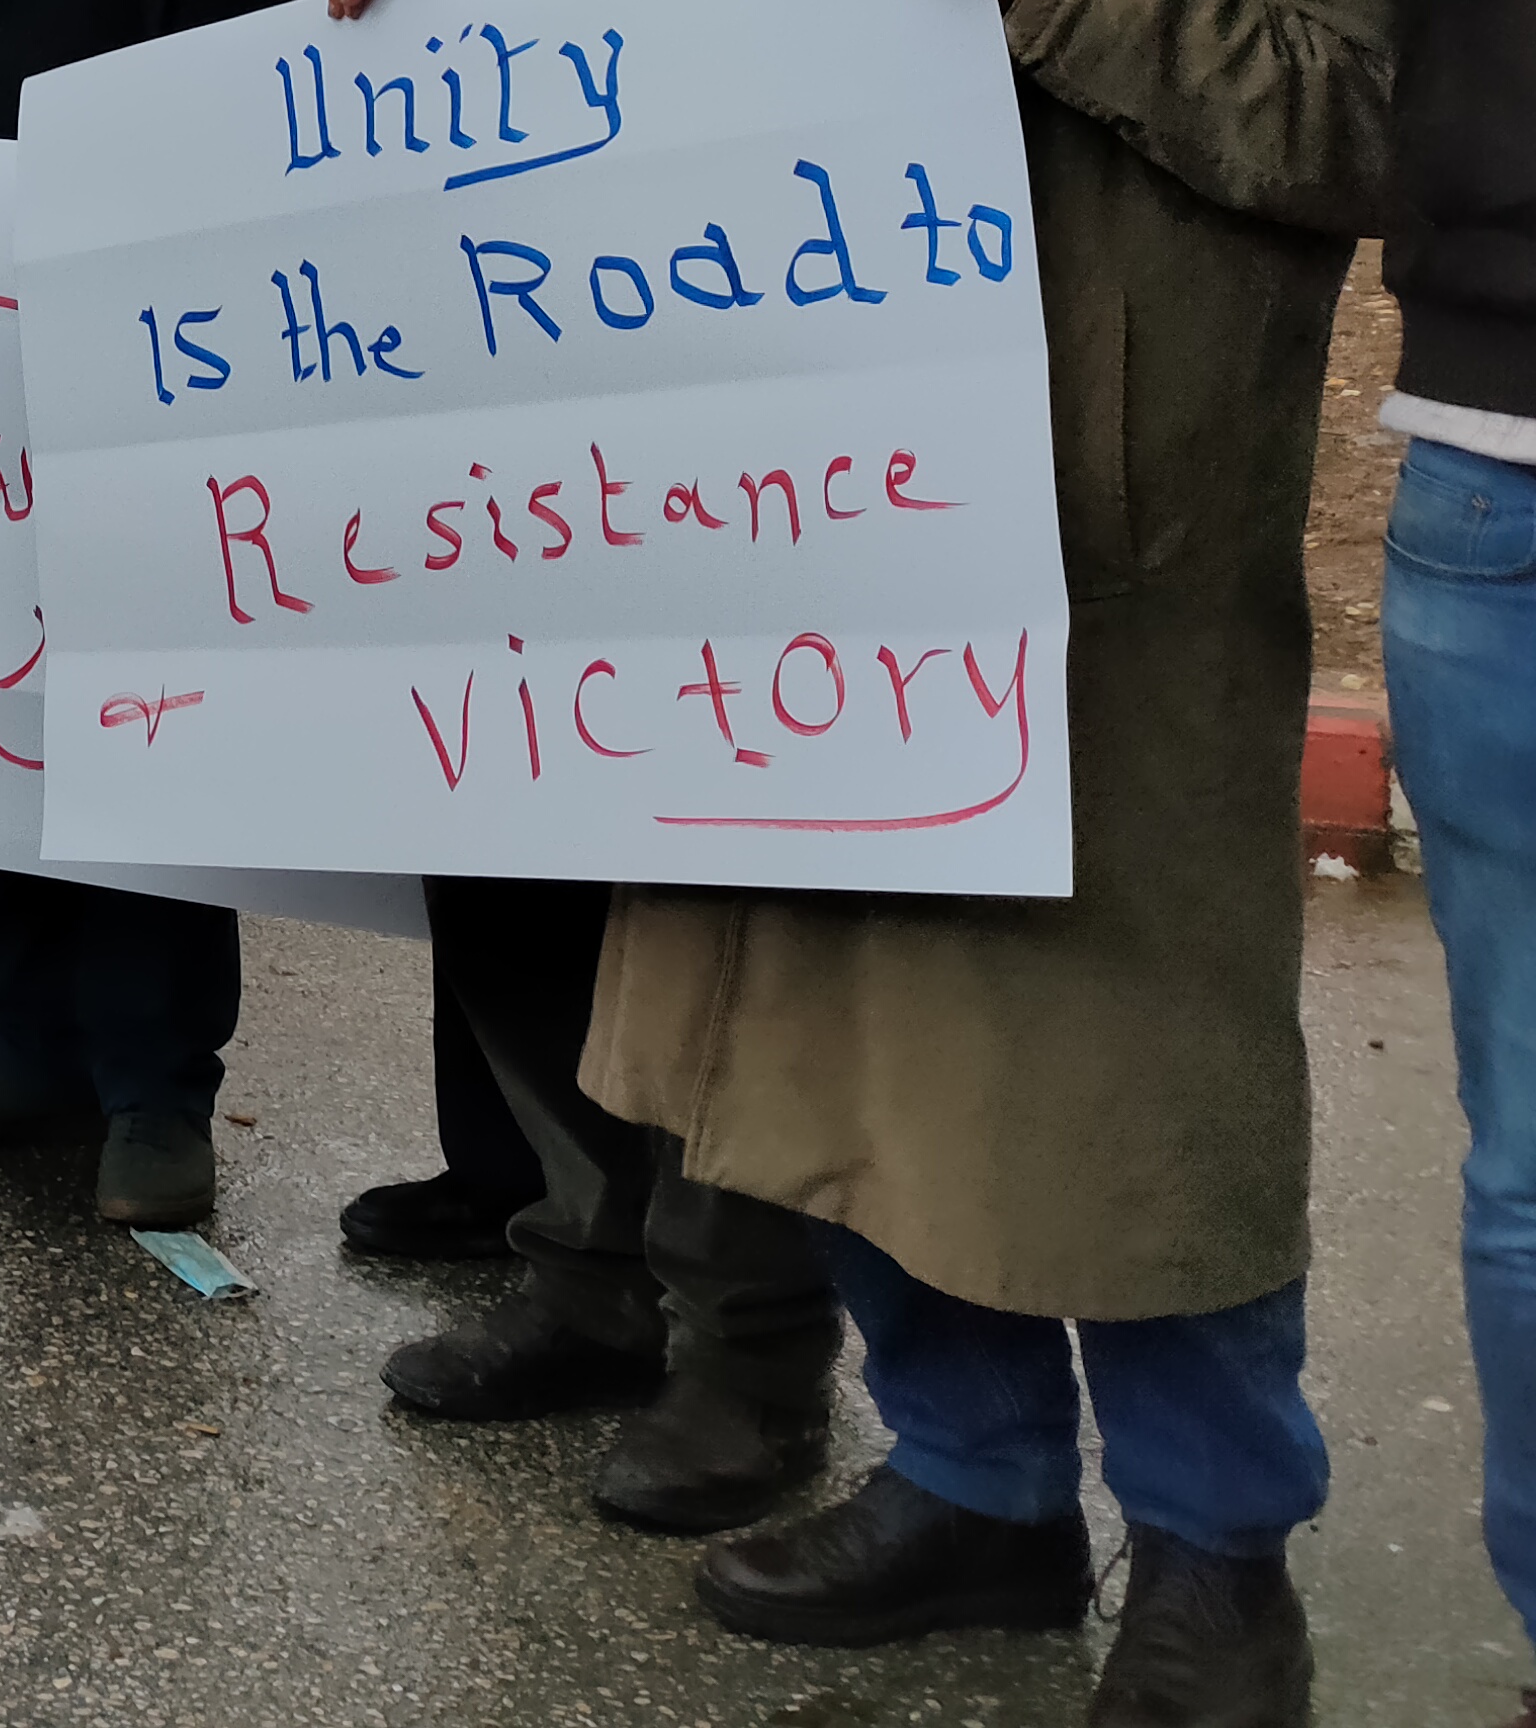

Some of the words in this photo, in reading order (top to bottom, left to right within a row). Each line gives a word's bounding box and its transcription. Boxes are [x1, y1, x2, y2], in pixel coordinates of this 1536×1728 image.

[274, 24, 625, 192] Unity
[269, 258, 426, 385] the
[458, 158, 889, 356] Road
[901, 161, 1016, 287] to
[206, 441, 971, 625] Resistance
